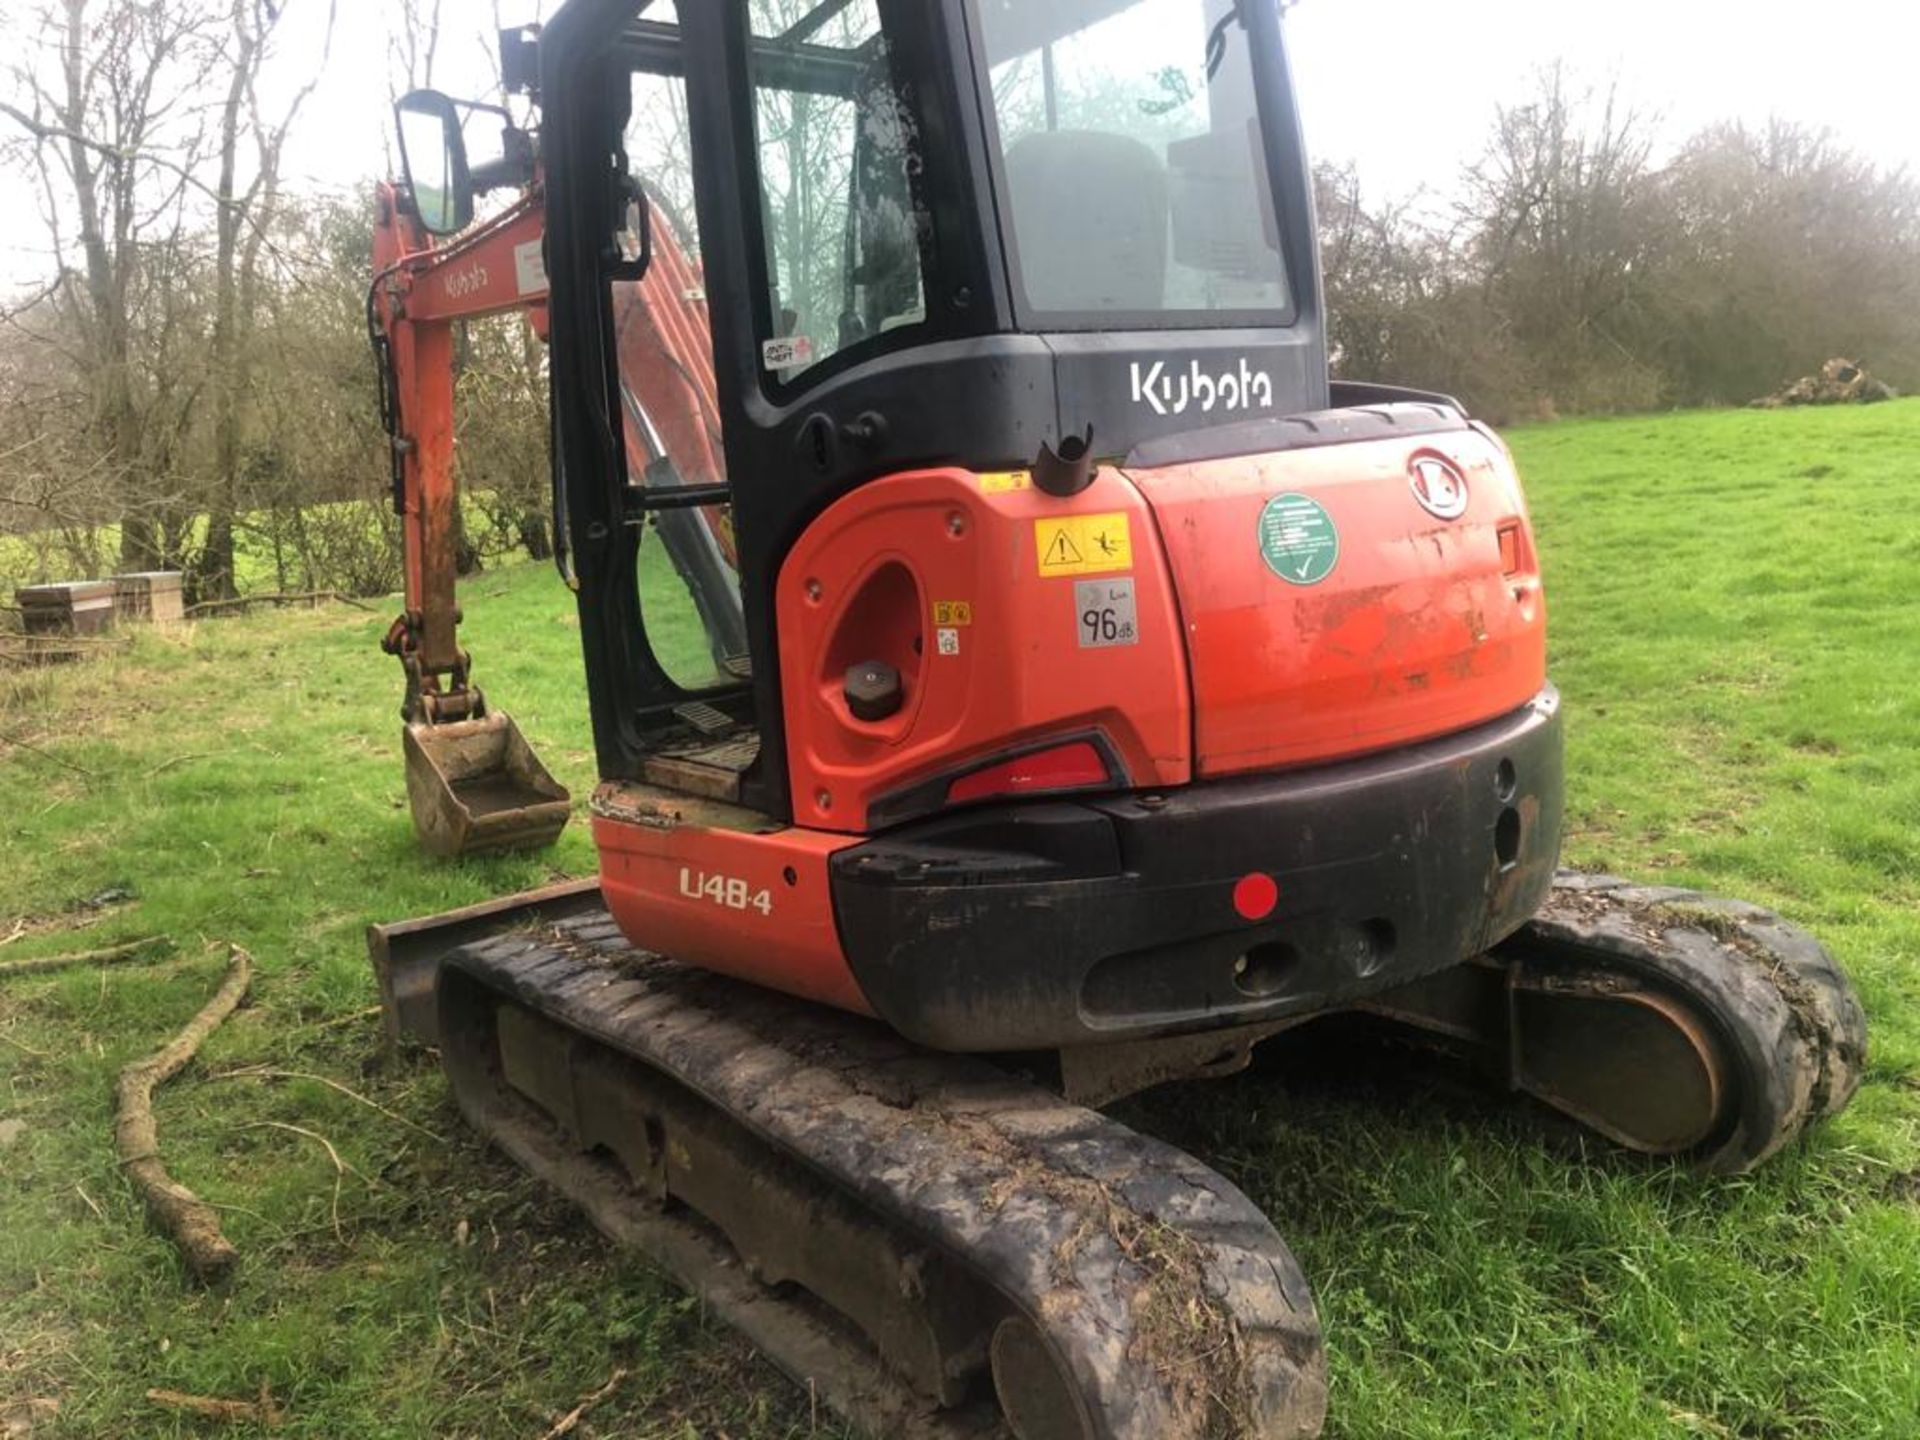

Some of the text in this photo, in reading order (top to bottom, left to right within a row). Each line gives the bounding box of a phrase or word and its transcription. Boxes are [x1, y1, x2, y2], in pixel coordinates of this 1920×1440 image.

[1130, 357, 1273, 415] Kubota
[1083, 608, 1117, 642] 96
[680, 867, 772, 916] U48-4
